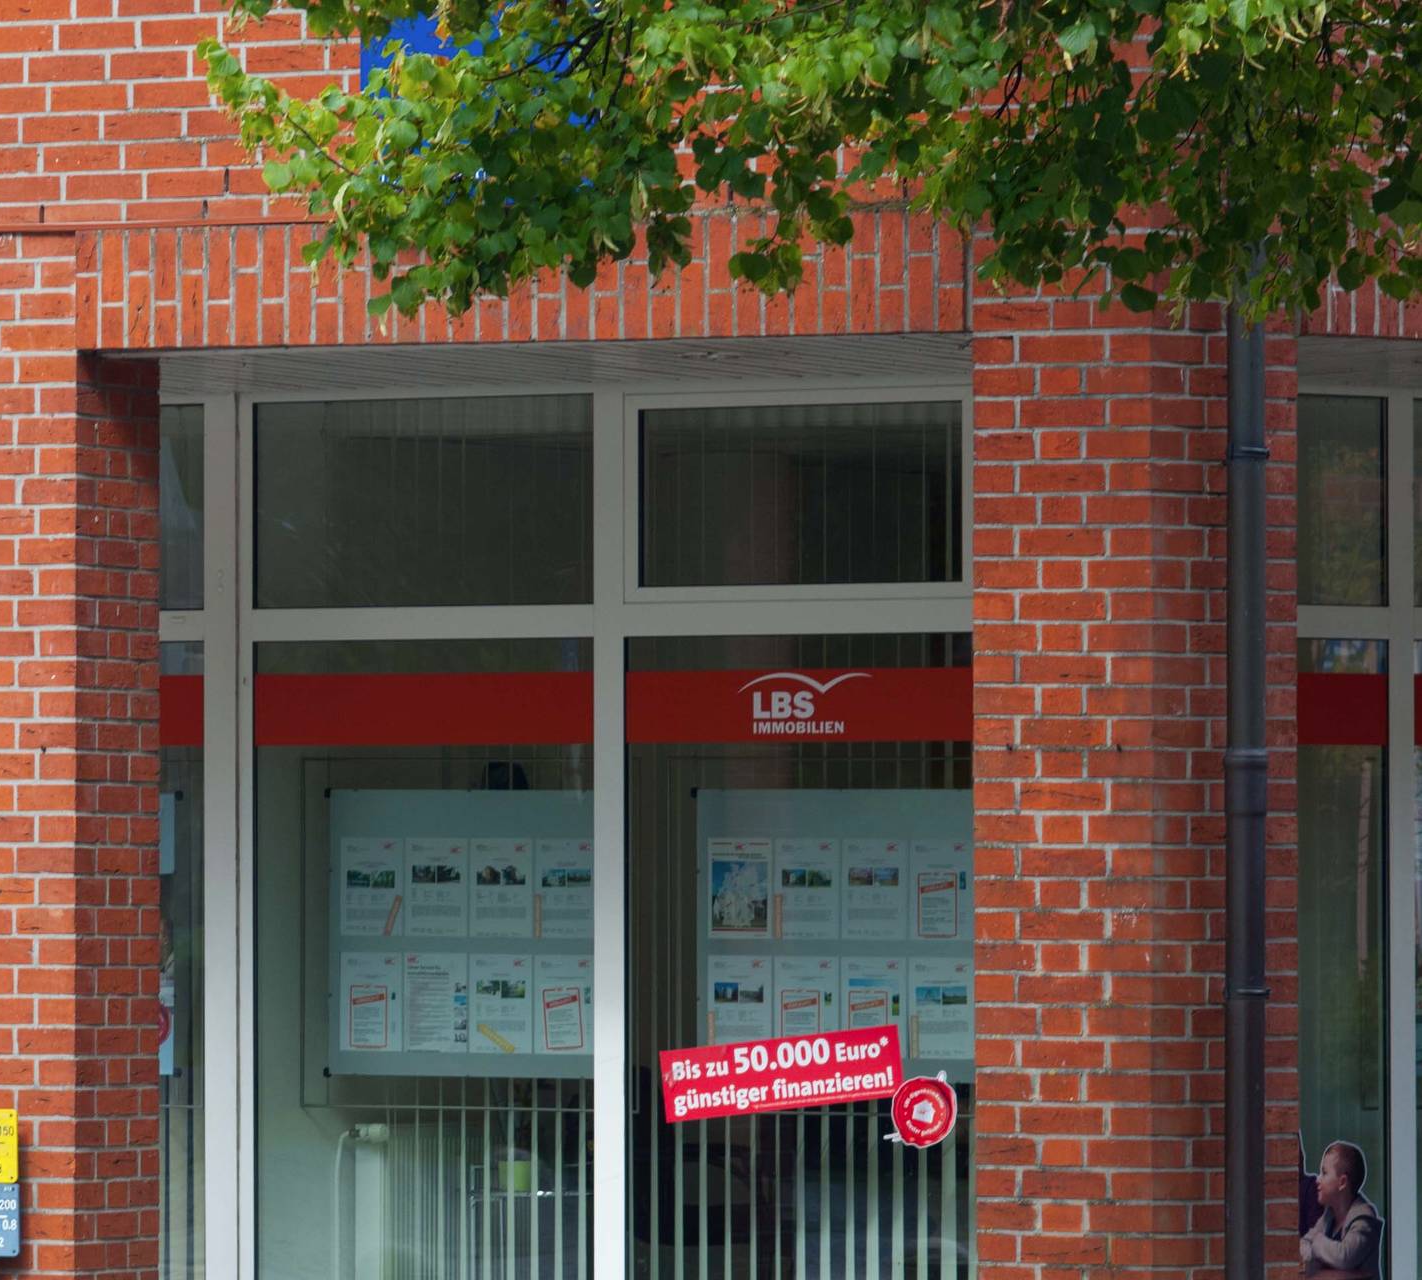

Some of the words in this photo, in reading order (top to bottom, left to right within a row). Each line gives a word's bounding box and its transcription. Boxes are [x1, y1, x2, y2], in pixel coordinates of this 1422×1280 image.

[753, 691, 815, 719] LBS
[753, 721, 845, 734] IMMOBILIEN
[672, 1060, 702, 1081] Bis
[705, 1059, 729, 1077] zu
[733, 1037, 830, 1074] 50.000
[674, 1083, 768, 1116] günstiger
[771, 1066, 894, 1099] finanzieren!
